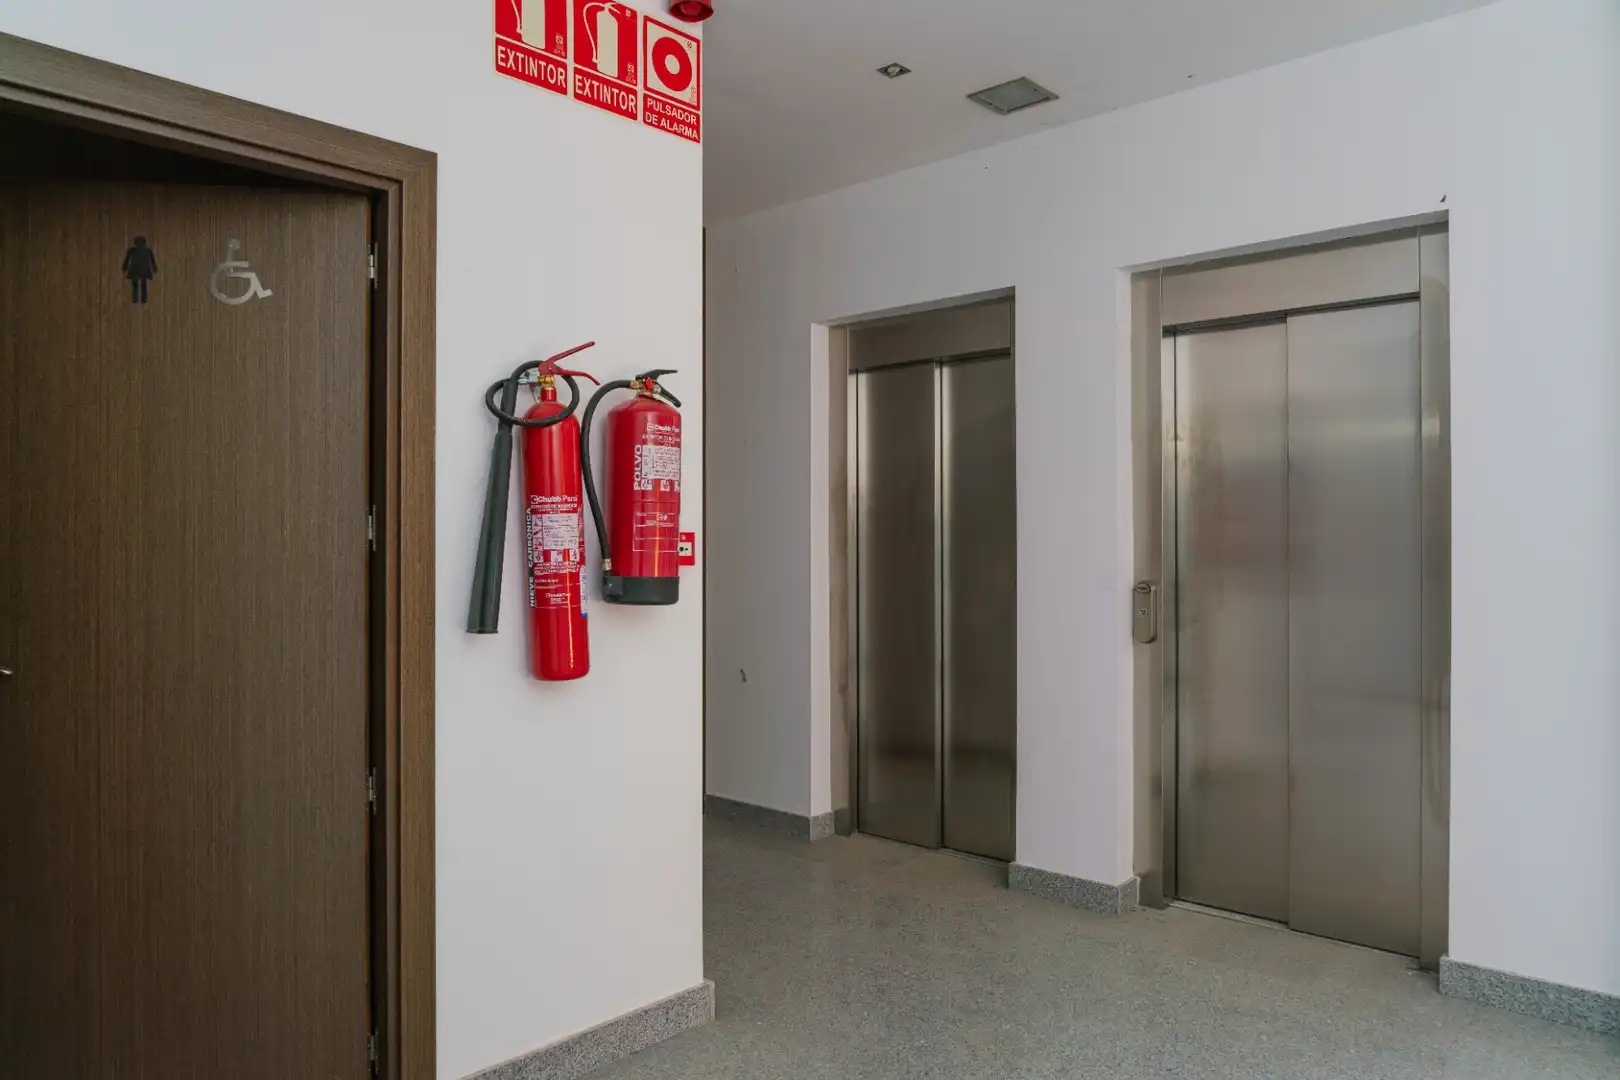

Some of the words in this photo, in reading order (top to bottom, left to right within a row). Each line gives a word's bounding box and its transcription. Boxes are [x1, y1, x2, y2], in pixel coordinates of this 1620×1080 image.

[497, 45, 567, 88] EXTINTOR
[575, 73, 637, 114] EXTINTOR
[645, 112, 659, 126] DE
[660, 117, 699, 140] ALARMA
[647, 97, 697, 126] PULSADOR
[633, 444, 642, 491] POLVO
[537, 495, 561, 503] Chubb
